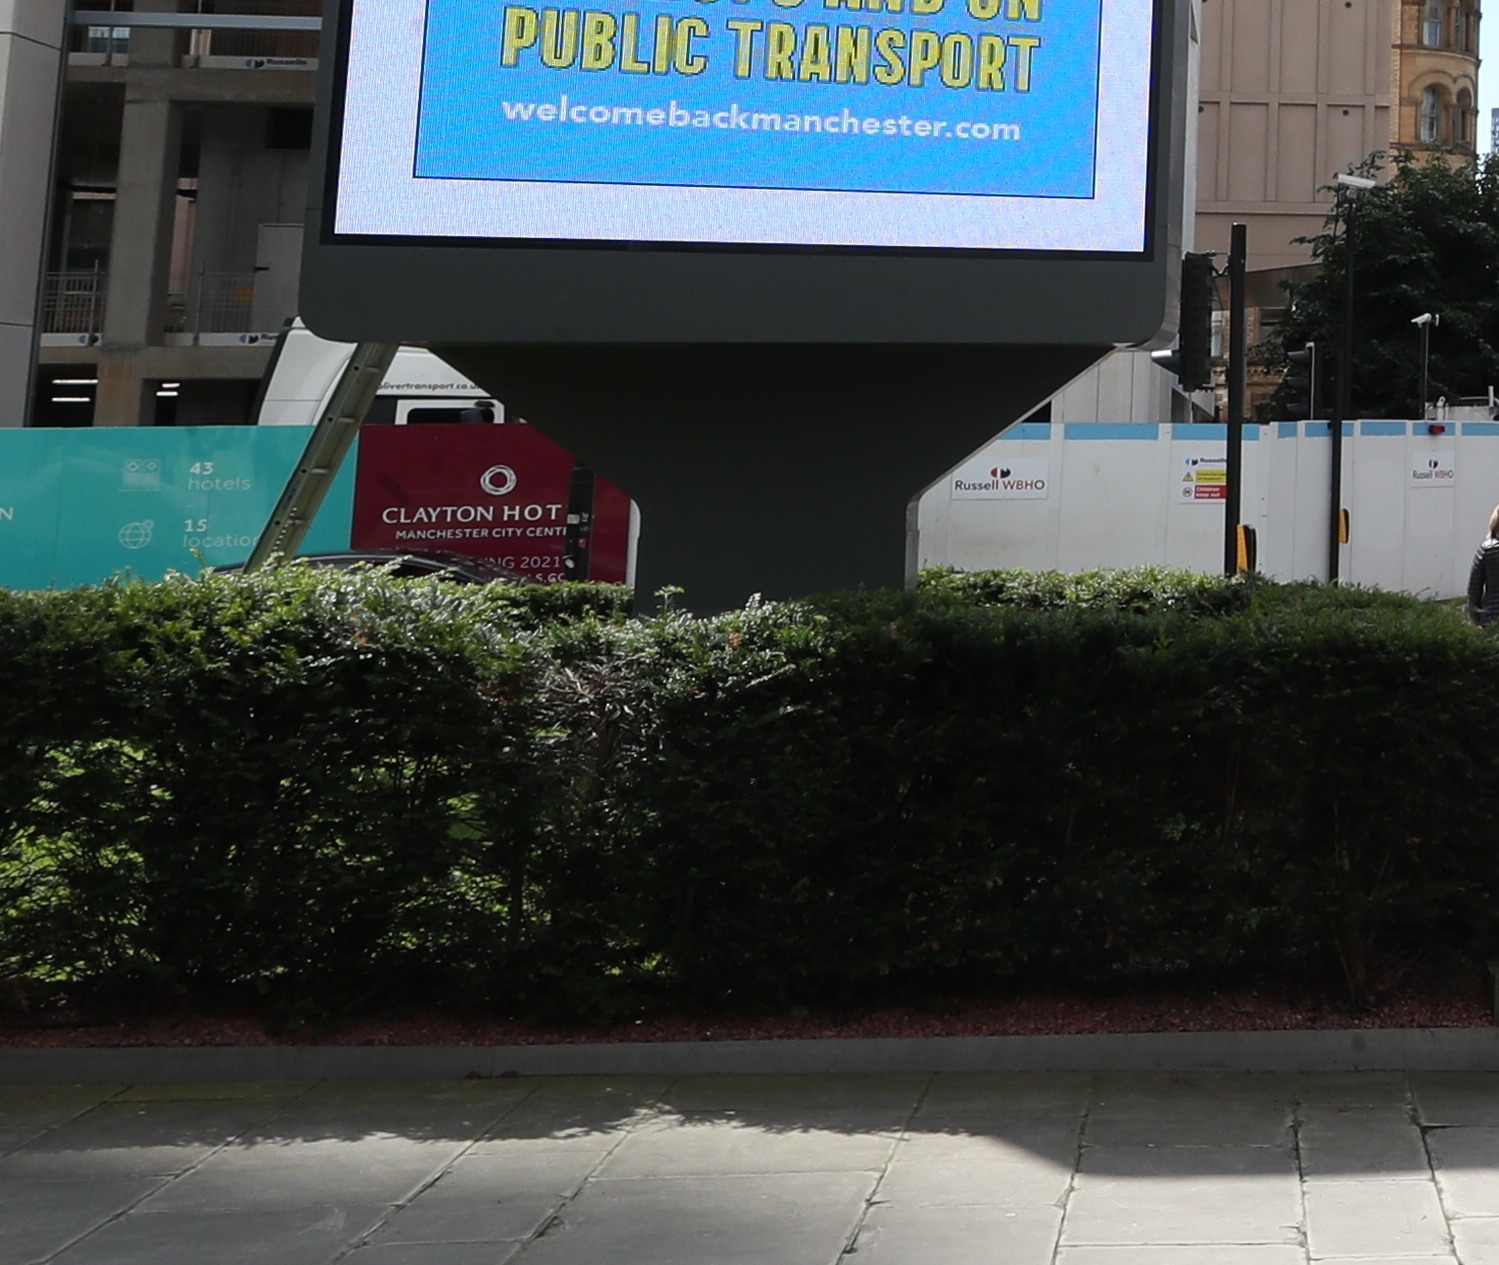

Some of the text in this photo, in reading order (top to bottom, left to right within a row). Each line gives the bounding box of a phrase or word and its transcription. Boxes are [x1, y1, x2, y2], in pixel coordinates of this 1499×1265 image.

[501, 6, 1041, 92] PUBLIC TRANSPORT
[502, 96, 1021, 140] welcomebackmanchester.com
[189, 462, 214, 475] 43
[188, 478, 251, 490] hotels
[954, 479, 1045, 491] Russell WBHO
[382, 504, 562, 524] CLAYTON HOT
[184, 519, 208, 532] 15
[395, 526, 567, 539] MANCHESTER CITY CENT
[183, 535, 257, 547] locatio
[520, 556, 560, 568] 2021
